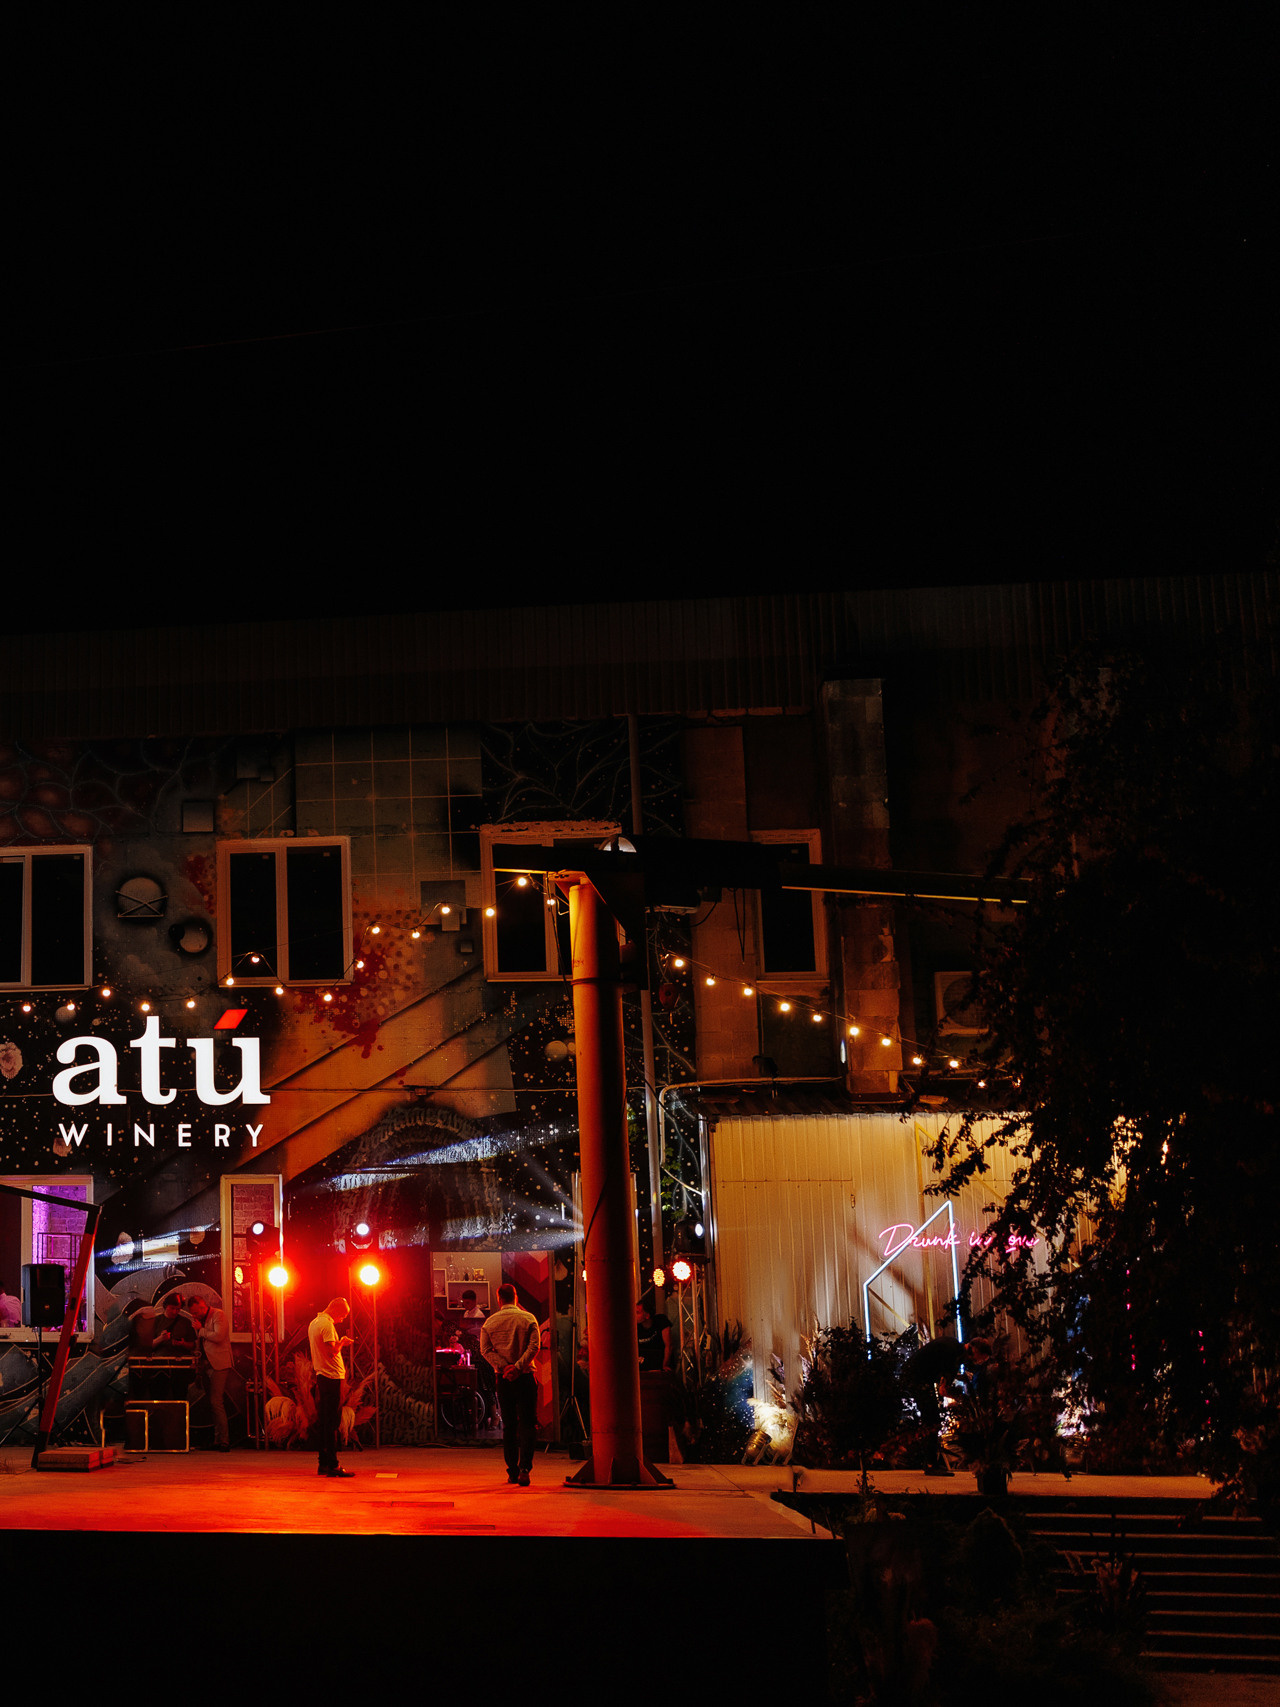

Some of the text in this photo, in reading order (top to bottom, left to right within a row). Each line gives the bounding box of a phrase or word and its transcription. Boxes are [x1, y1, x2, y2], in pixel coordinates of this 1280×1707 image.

[52, 1008, 271, 1106] atú
[58, 1123, 264, 1147] WINERY
[878, 1222, 960, 1257] Drunk
